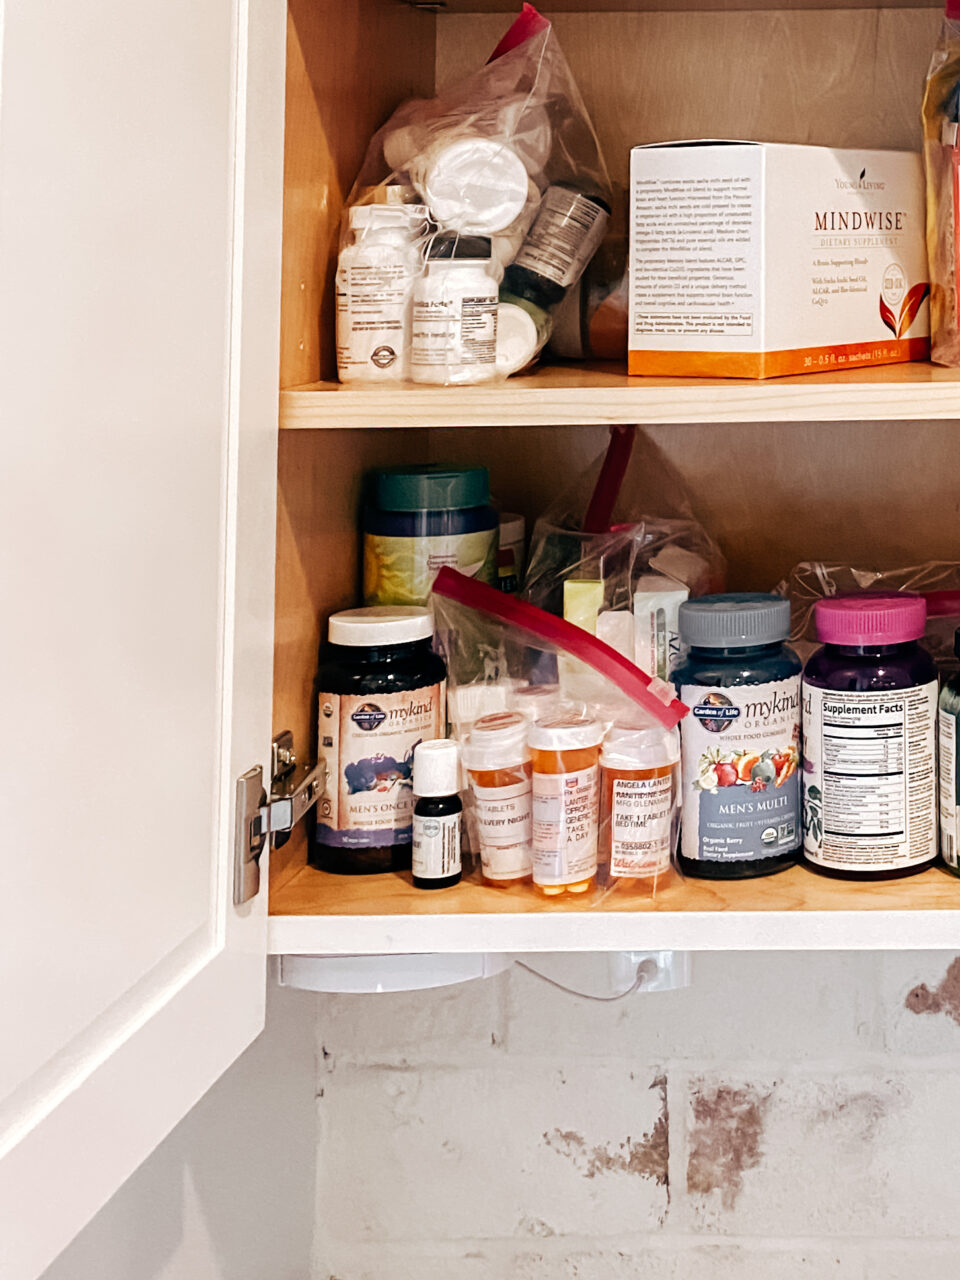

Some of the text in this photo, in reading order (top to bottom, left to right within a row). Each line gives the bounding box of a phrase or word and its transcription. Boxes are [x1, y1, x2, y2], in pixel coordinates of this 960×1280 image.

[820, 236, 899, 247] DIETARY SUPPLEMENT
[819, 353, 830, 366] 0.5
[848, 352, 872, 362] sachets
[744, 685, 800, 720] mykind
[389, 697, 434, 721] mykind
[694, 707, 717, 716] Garden
[725, 707, 739, 716] Life
[823, 703, 904, 716] Supplement Facts
[743, 731, 762, 740] FOOD
[616, 781, 647, 790] ANGELA
[350, 799, 411, 814] MEN'S ONCE
[719, 795, 788, 815] MEN'S MULTI
[615, 813, 634, 821] TAKE
[642, 809, 667, 821] TABLET
[566, 823, 586, 834] TAKE
[615, 820, 649, 829] BEDTIME
[706, 821, 735, 830] ORGANIC
[735, 820, 754, 829] FRUIT
[575, 831, 590, 842] DAY
[702, 836, 744, 845] Organic Berry
[702, 850, 755, 859] Dietary Supplement
